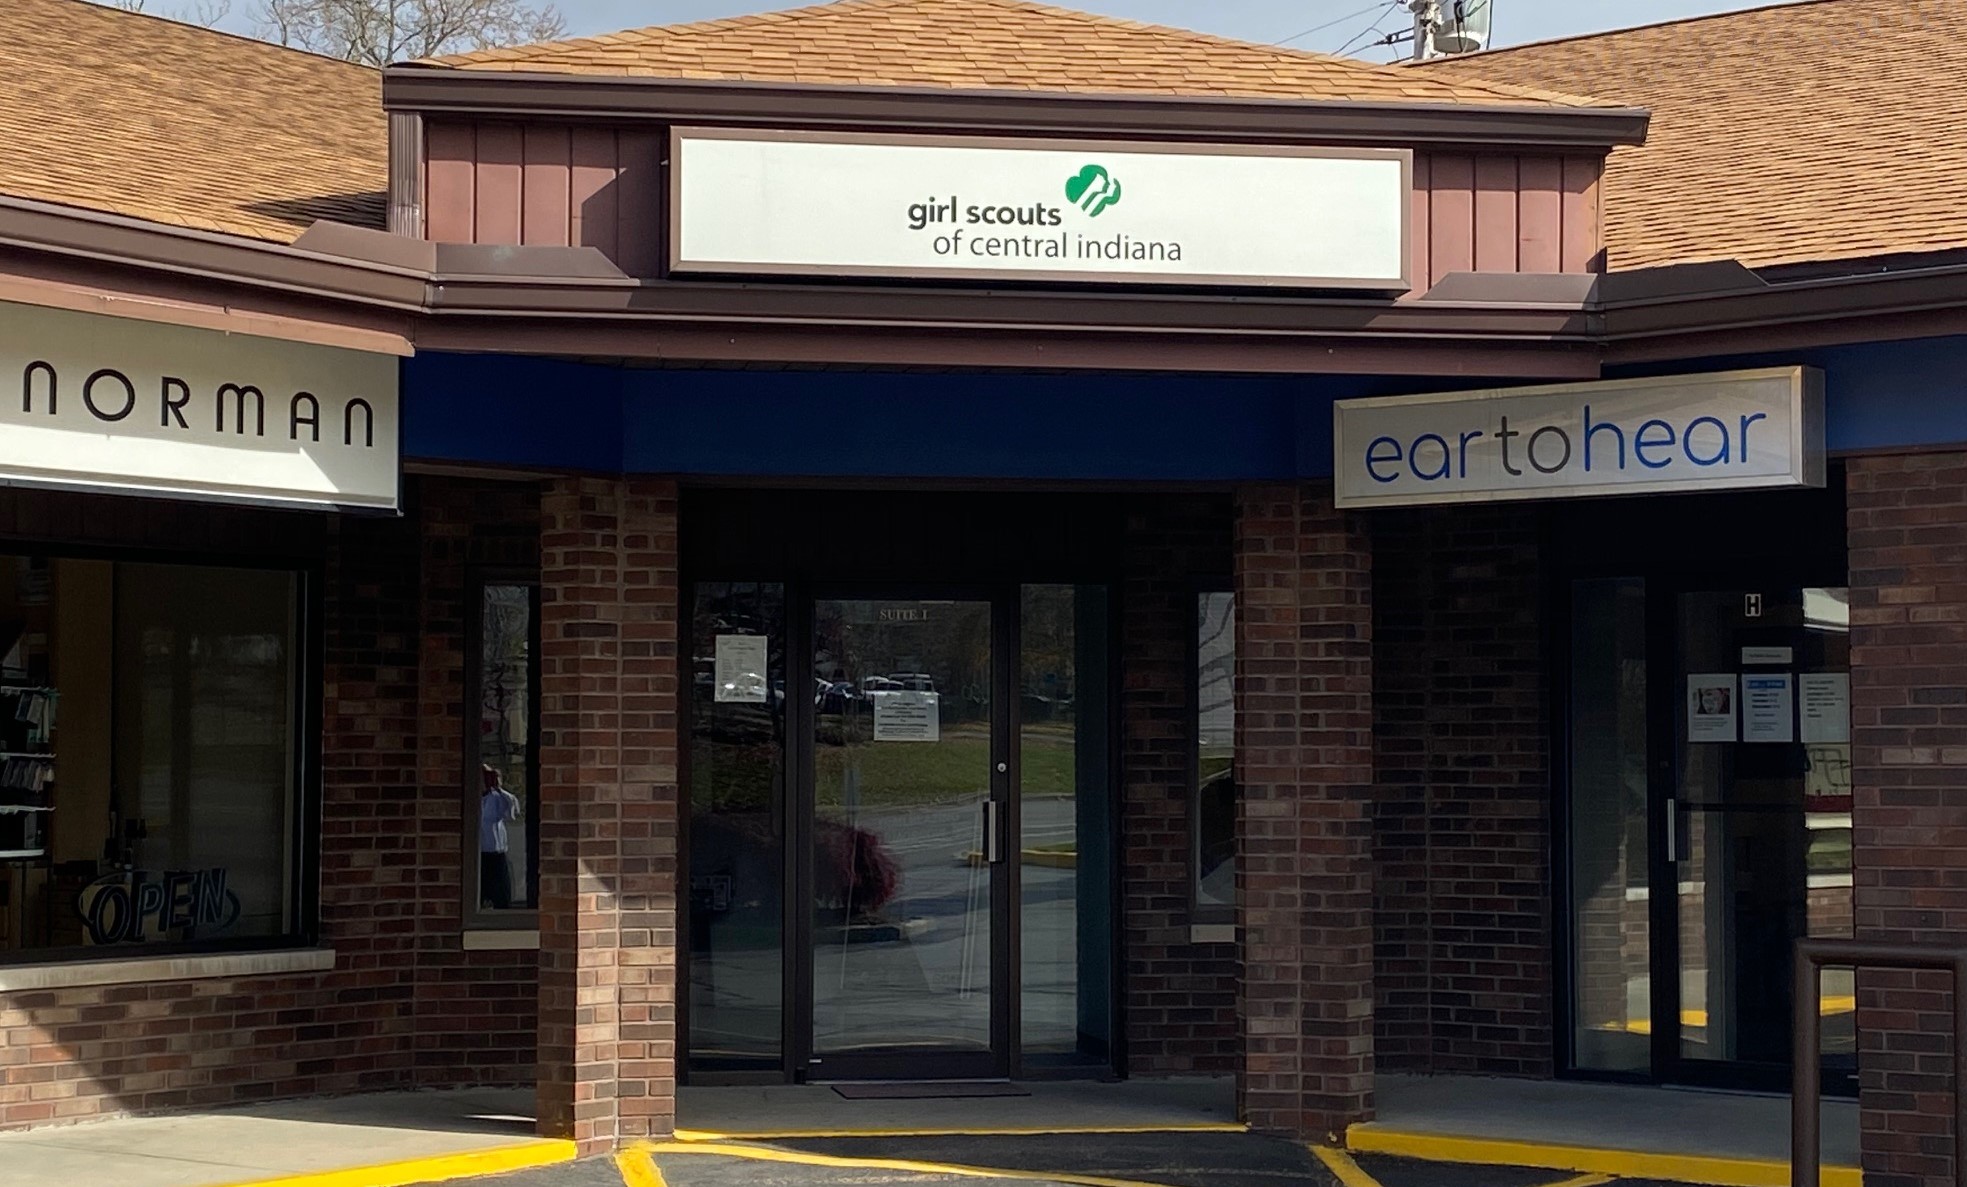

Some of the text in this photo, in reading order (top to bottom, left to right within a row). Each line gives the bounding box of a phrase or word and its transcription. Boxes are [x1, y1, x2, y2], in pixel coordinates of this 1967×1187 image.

[908, 196, 1062, 230] girl scouts
[933, 229, 1182, 262] of central indiana
[22, 359, 374, 447] NORMAN
[879, 608, 917, 622] SUITE
[1746, 594, 1760, 616] H
[89, 867, 229, 945] OPEN
